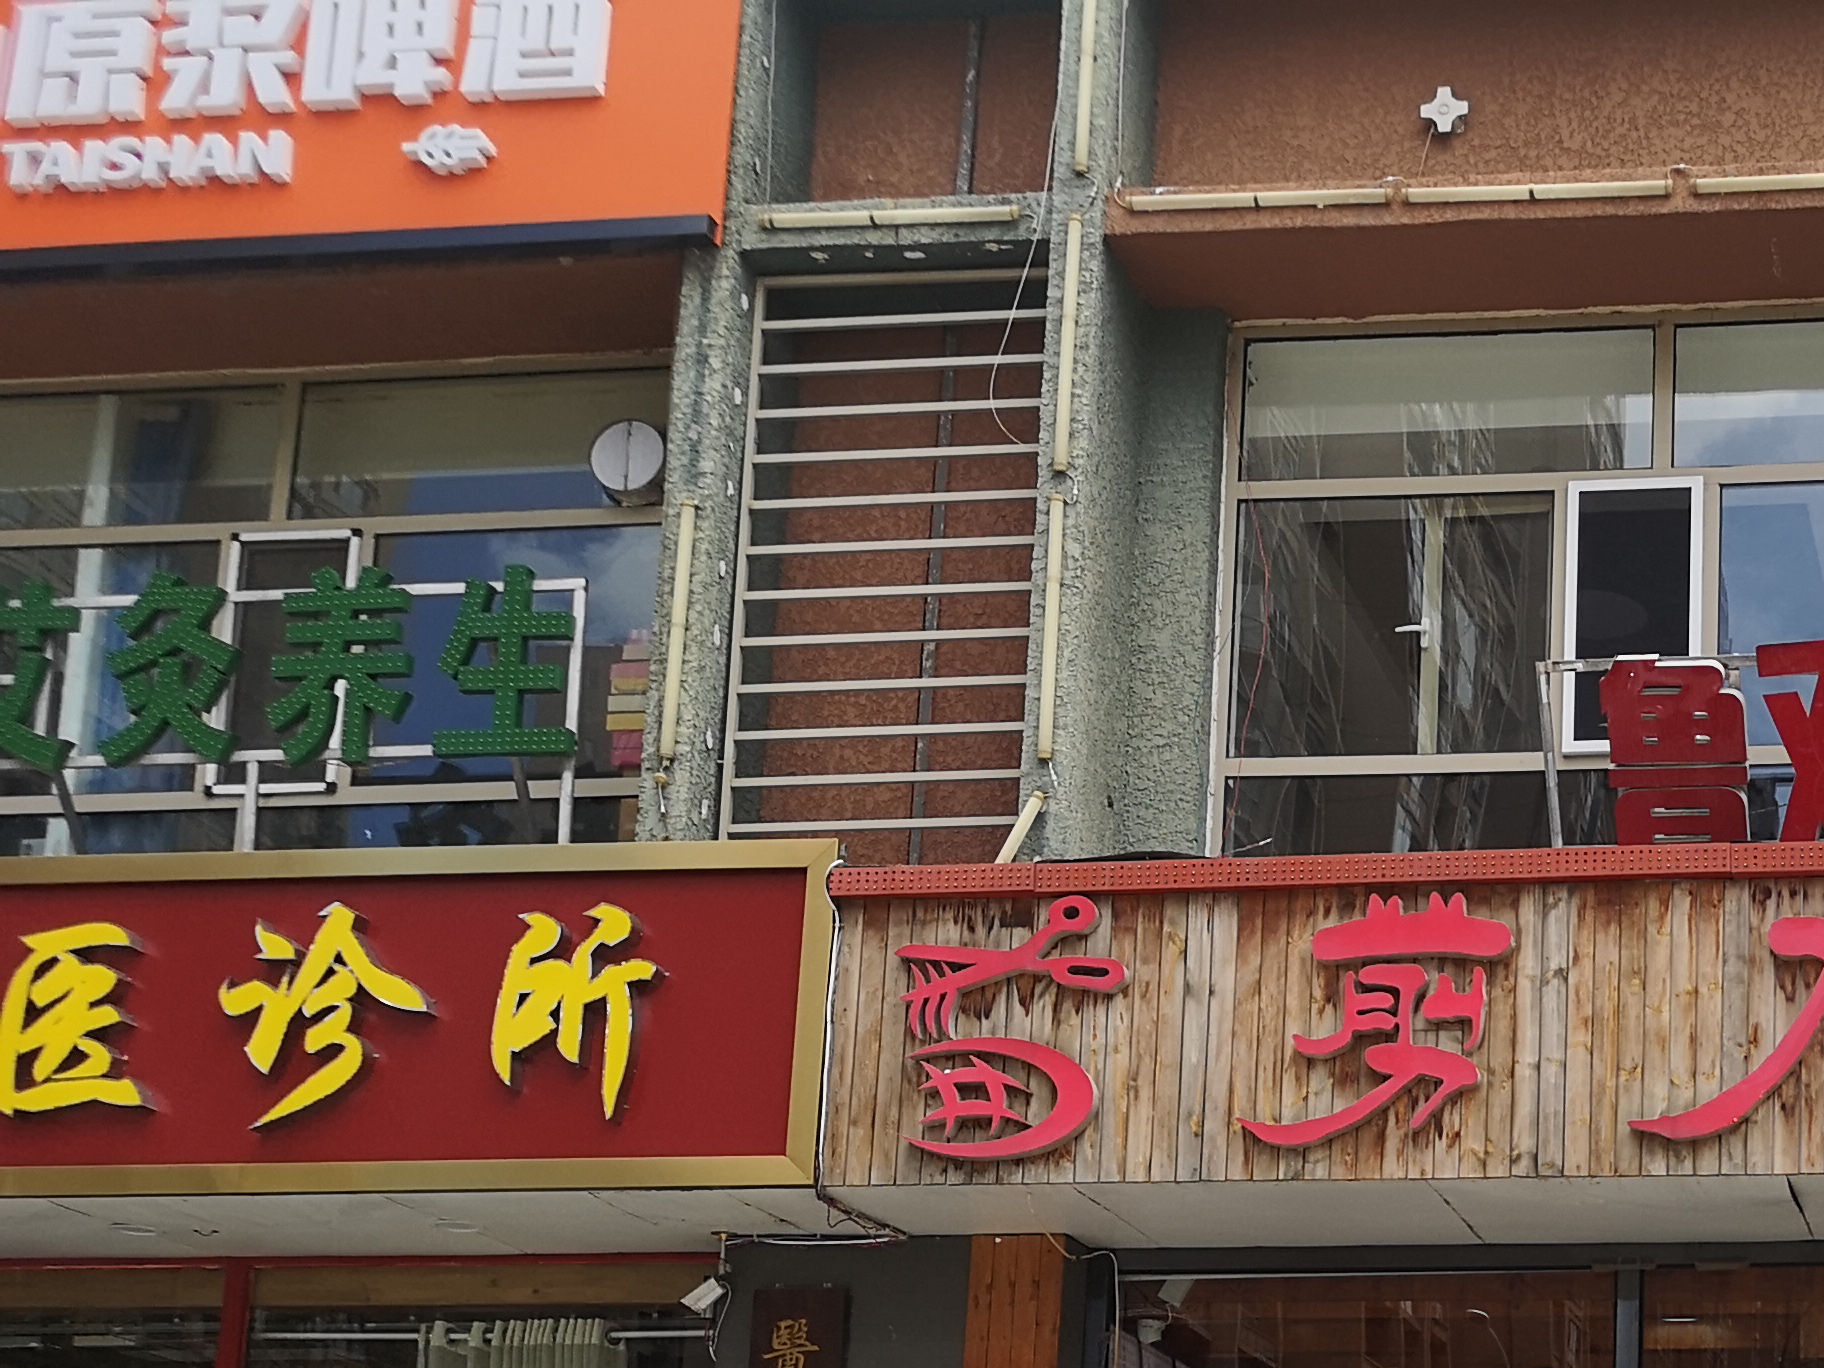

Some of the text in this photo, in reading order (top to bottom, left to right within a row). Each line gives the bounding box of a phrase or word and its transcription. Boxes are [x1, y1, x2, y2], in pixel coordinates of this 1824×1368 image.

[4, 0, 612, 128] 原浆啤酒
[2, 128, 294, 194] TAISHAN
[0, 564, 578, 772] 艾灸养生
[0, 901, 670, 1136] 医诊所
